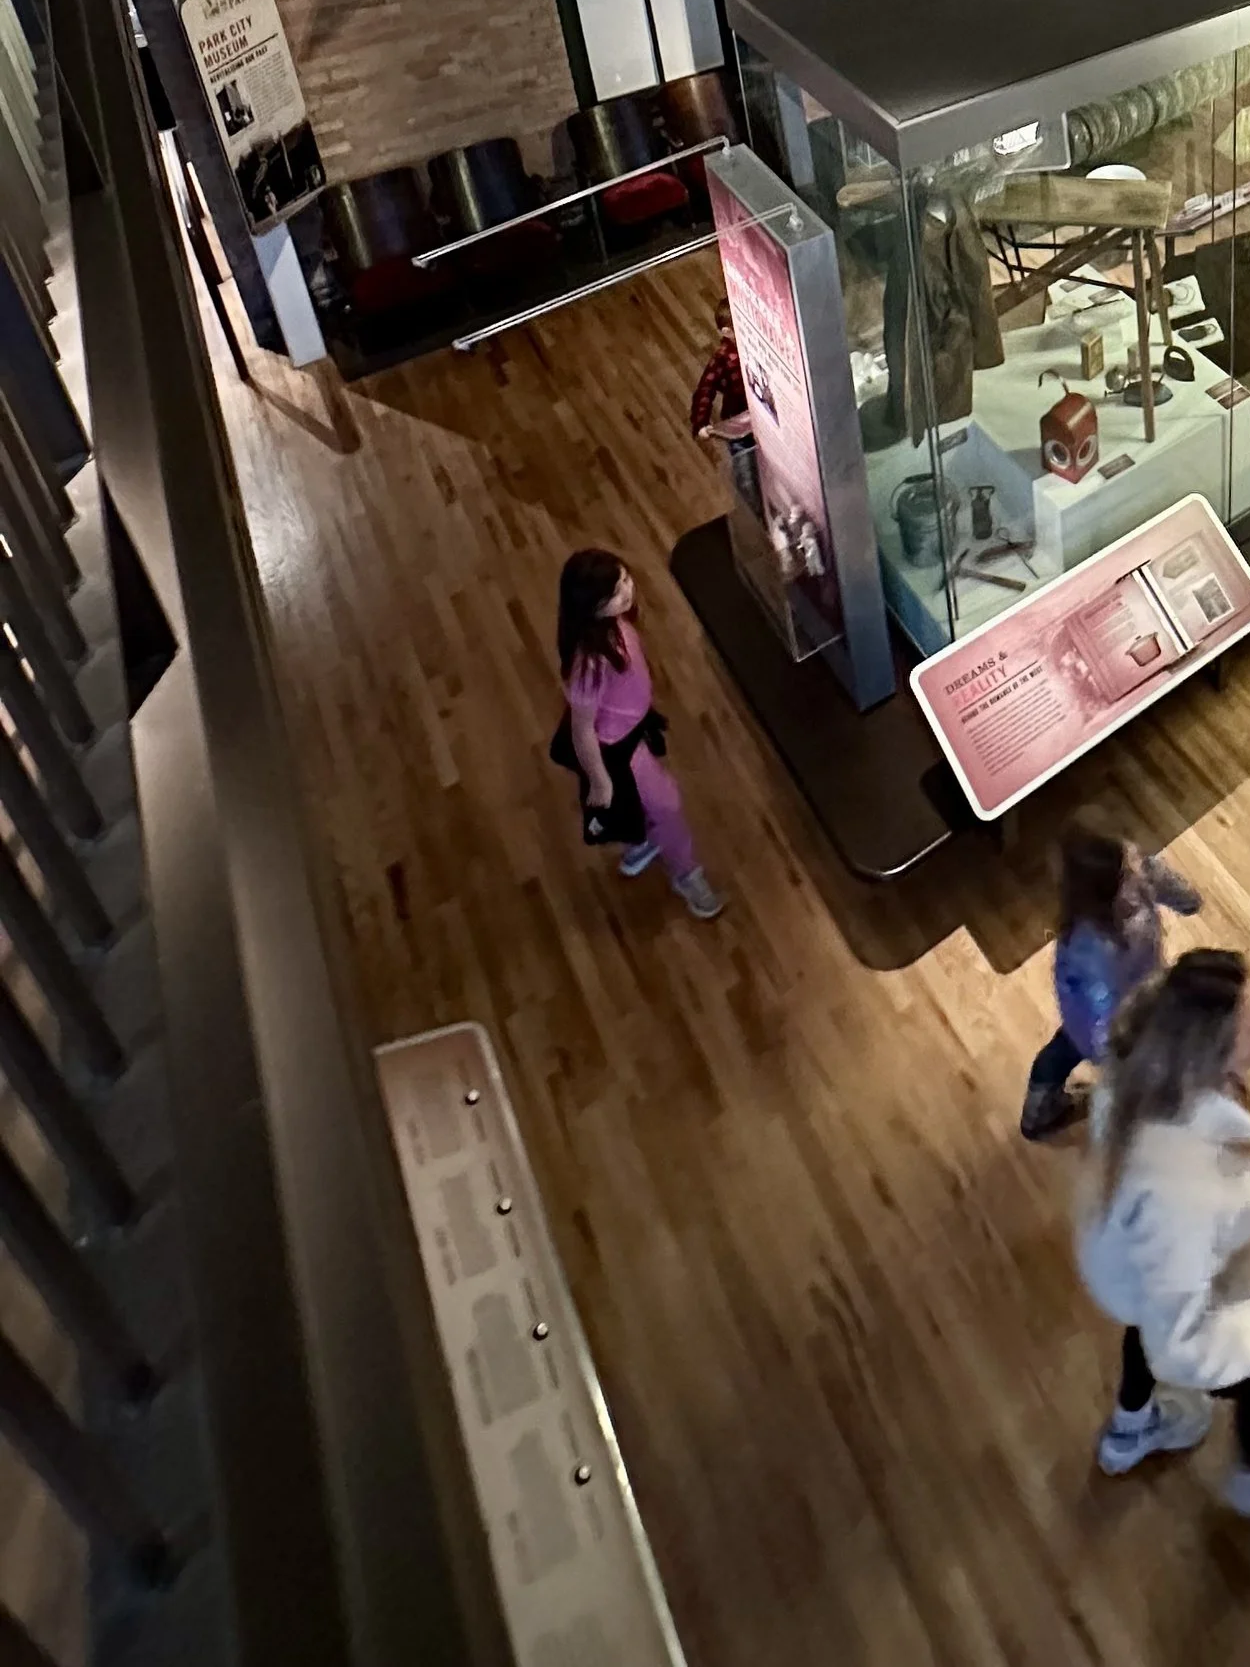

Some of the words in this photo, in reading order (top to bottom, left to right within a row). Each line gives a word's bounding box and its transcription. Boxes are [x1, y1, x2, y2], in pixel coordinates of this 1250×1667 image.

[198, 29, 228, 55] PARK
[229, 15, 253, 38] CITY
[203, 34, 249, 70] MUSEUM
[944, 656, 997, 696] DREAMS
[997, 650, 1009, 662] &
